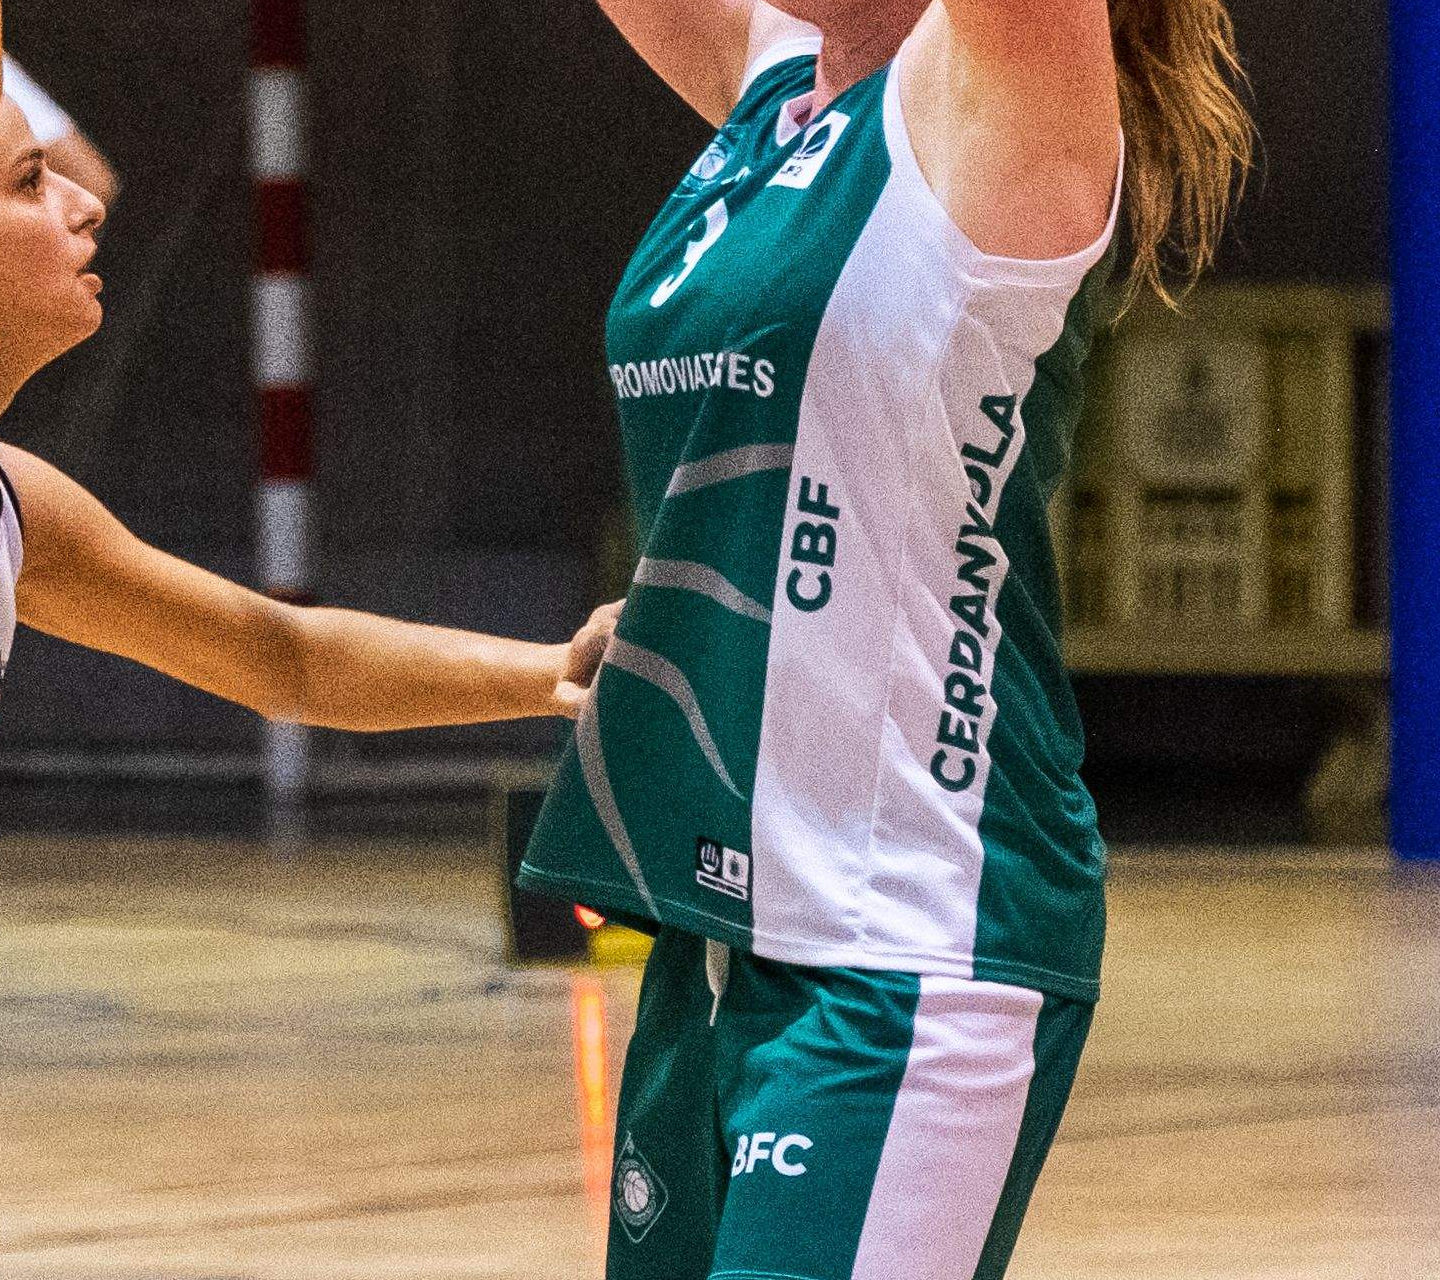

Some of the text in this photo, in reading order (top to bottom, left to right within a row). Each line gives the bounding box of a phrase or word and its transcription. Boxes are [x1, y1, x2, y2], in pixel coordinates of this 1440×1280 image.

[609, 351, 776, 399] ROMOVIATES
[786, 475, 841, 613] CBF
[929, 393, 1018, 793] CERDANYOLA
